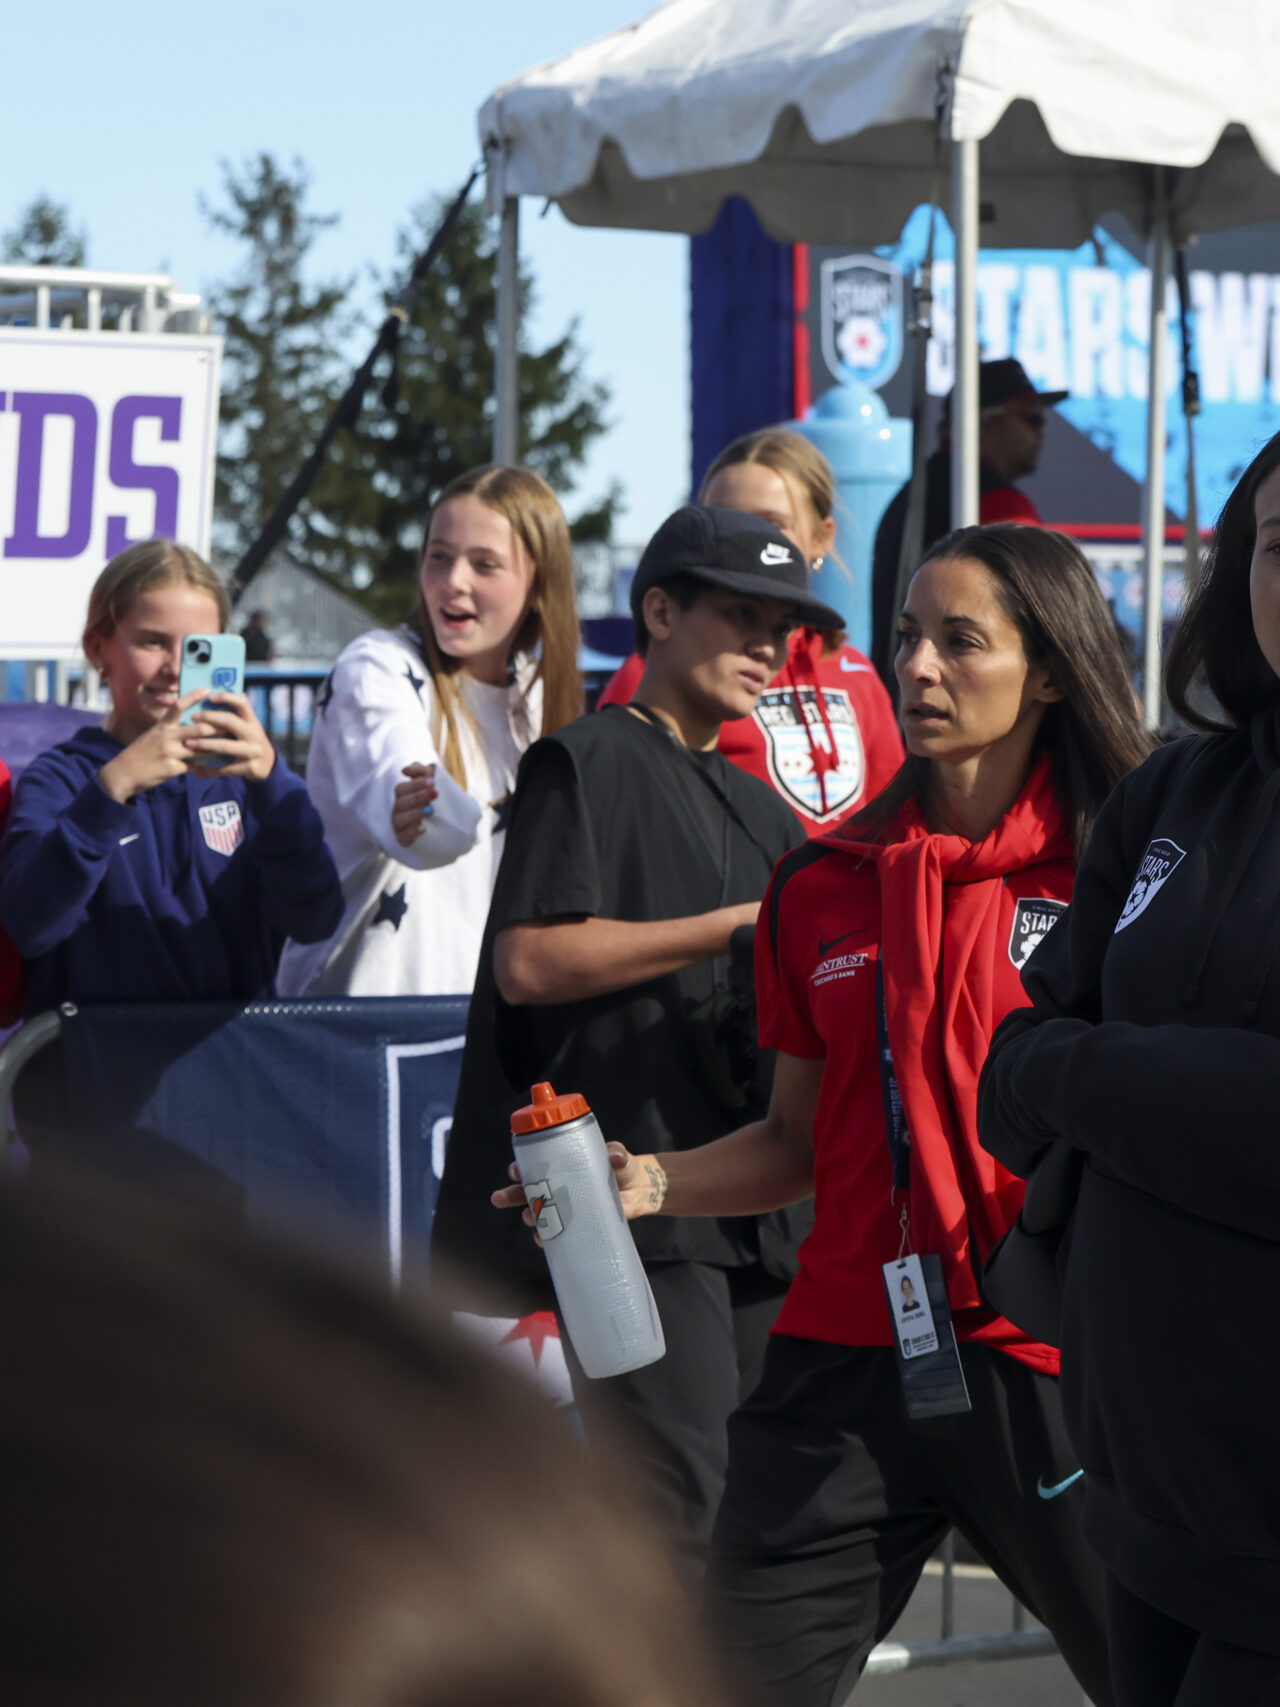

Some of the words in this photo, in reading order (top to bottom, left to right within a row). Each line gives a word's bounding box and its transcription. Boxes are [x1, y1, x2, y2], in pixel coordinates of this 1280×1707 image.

[0, 391, 182, 561] DS
[1020, 911, 1058, 934] STAR
[816, 953, 868, 975] NTRUST
